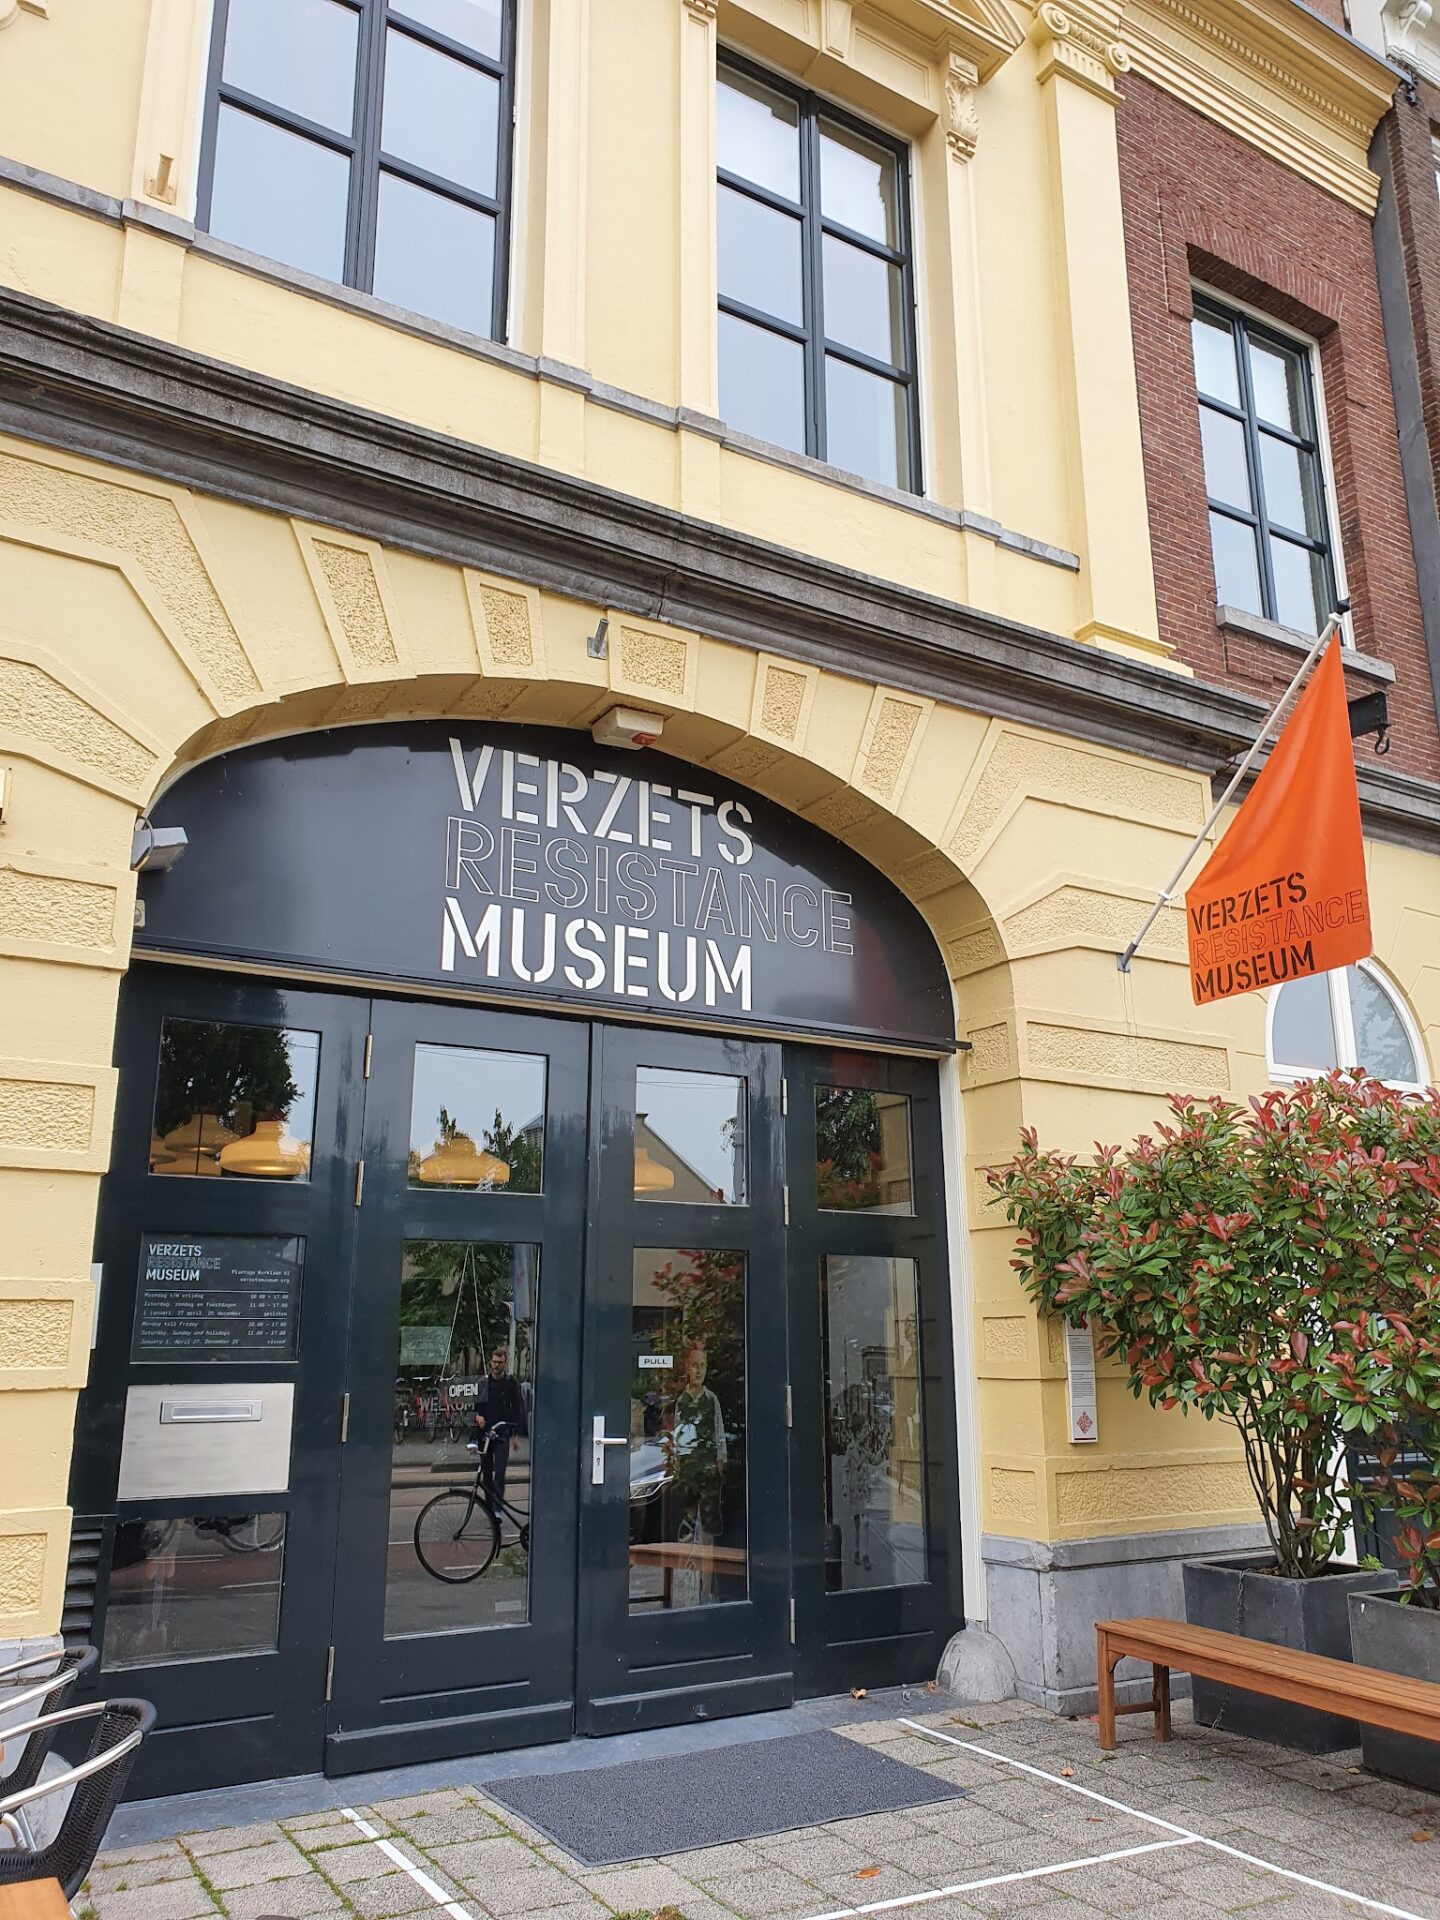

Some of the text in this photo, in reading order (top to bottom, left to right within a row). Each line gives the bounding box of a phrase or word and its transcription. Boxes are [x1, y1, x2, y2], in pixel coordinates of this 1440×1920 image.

[449, 737, 753, 865] VERZETS
[445, 816, 854, 955] RESISTANCE
[1191, 872, 1307, 935] VERZETS
[442, 897, 752, 1011] MUSEUM
[1193, 889, 1365, 969] RESISTANCE
[1195, 941, 1315, 1001] MUSEUM
[146, 1269, 200, 1281] MUSEUM
[147, 1256, 221, 1270] RESISTANCE
[149, 1244, 202, 1256] VERZETS
[448, 1383, 479, 1398] OPEN
